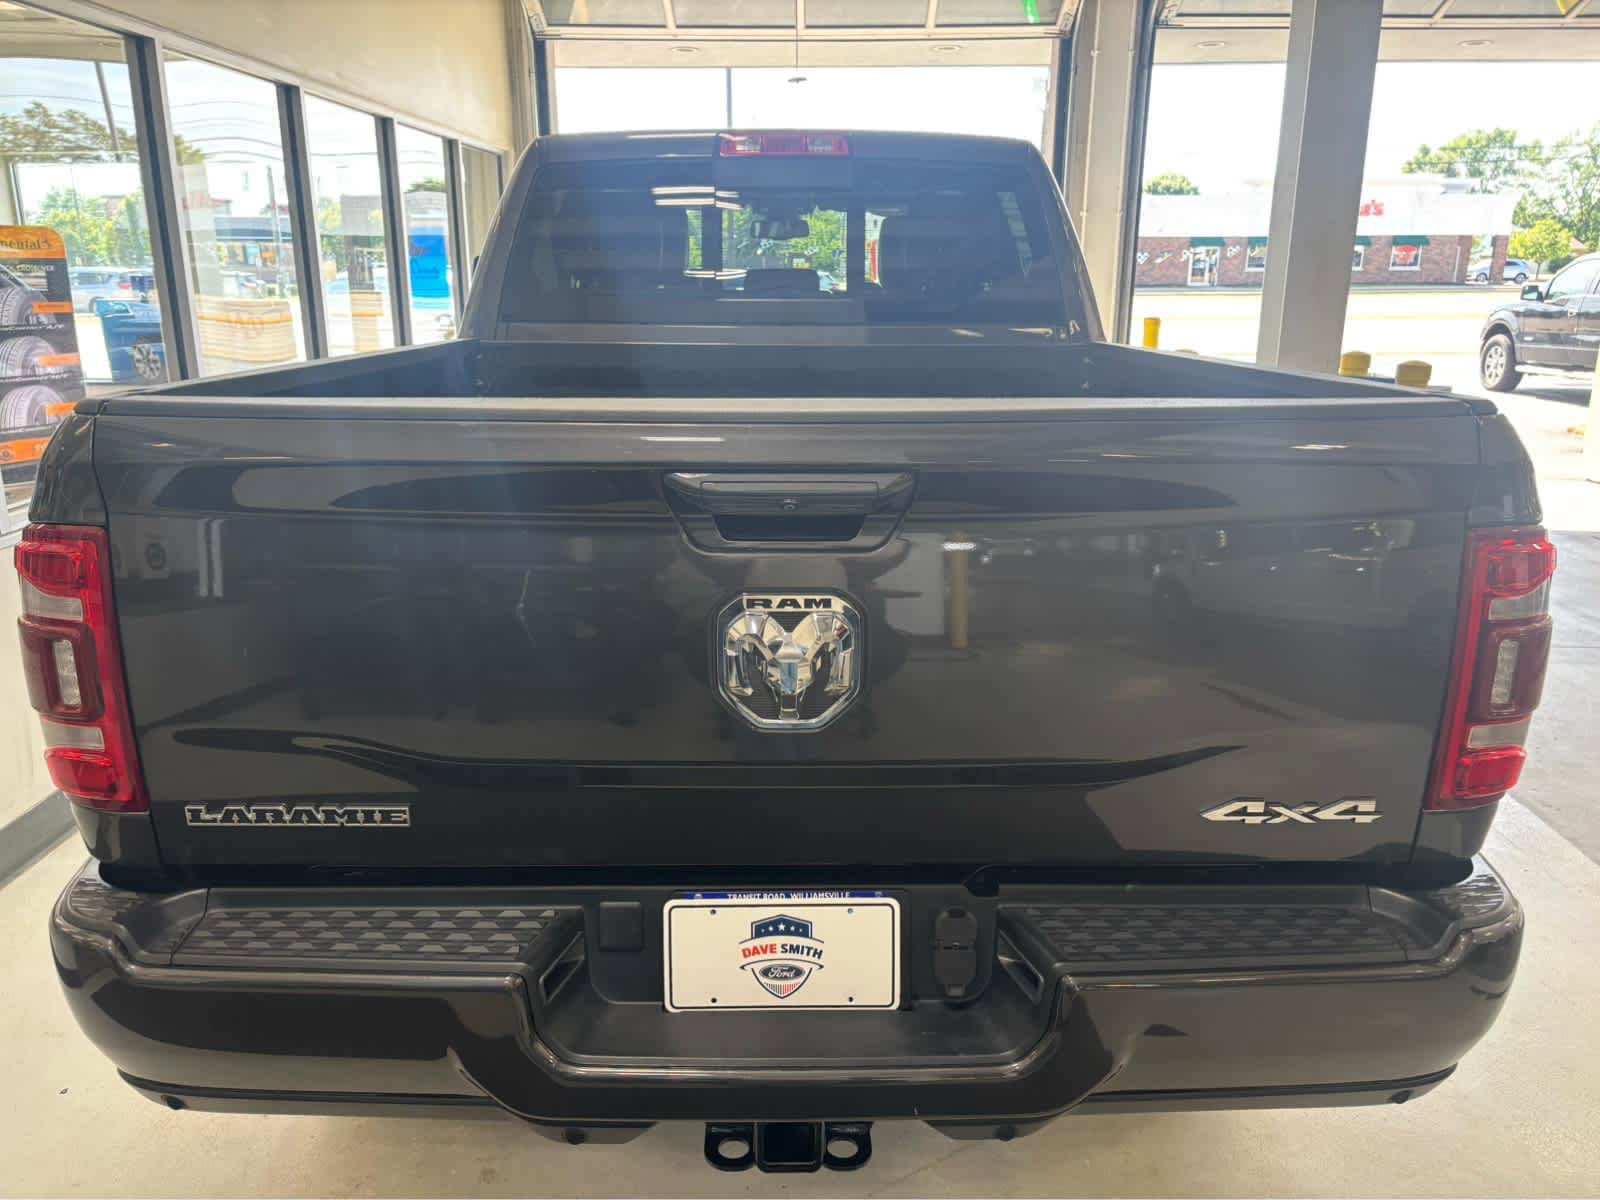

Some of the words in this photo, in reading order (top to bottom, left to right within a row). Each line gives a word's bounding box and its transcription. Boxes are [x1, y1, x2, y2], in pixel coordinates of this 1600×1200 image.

[745, 598, 832, 609] RAM
[184, 804, 411, 828] LARAMIE
[1200, 799, 1384, 824] 4x4
[790, 891, 850, 899] WILLIAMSVILLE
[741, 943, 777, 958] DAVE
[780, 943, 823, 960] SMITH
[768, 966, 796, 978] Ford
